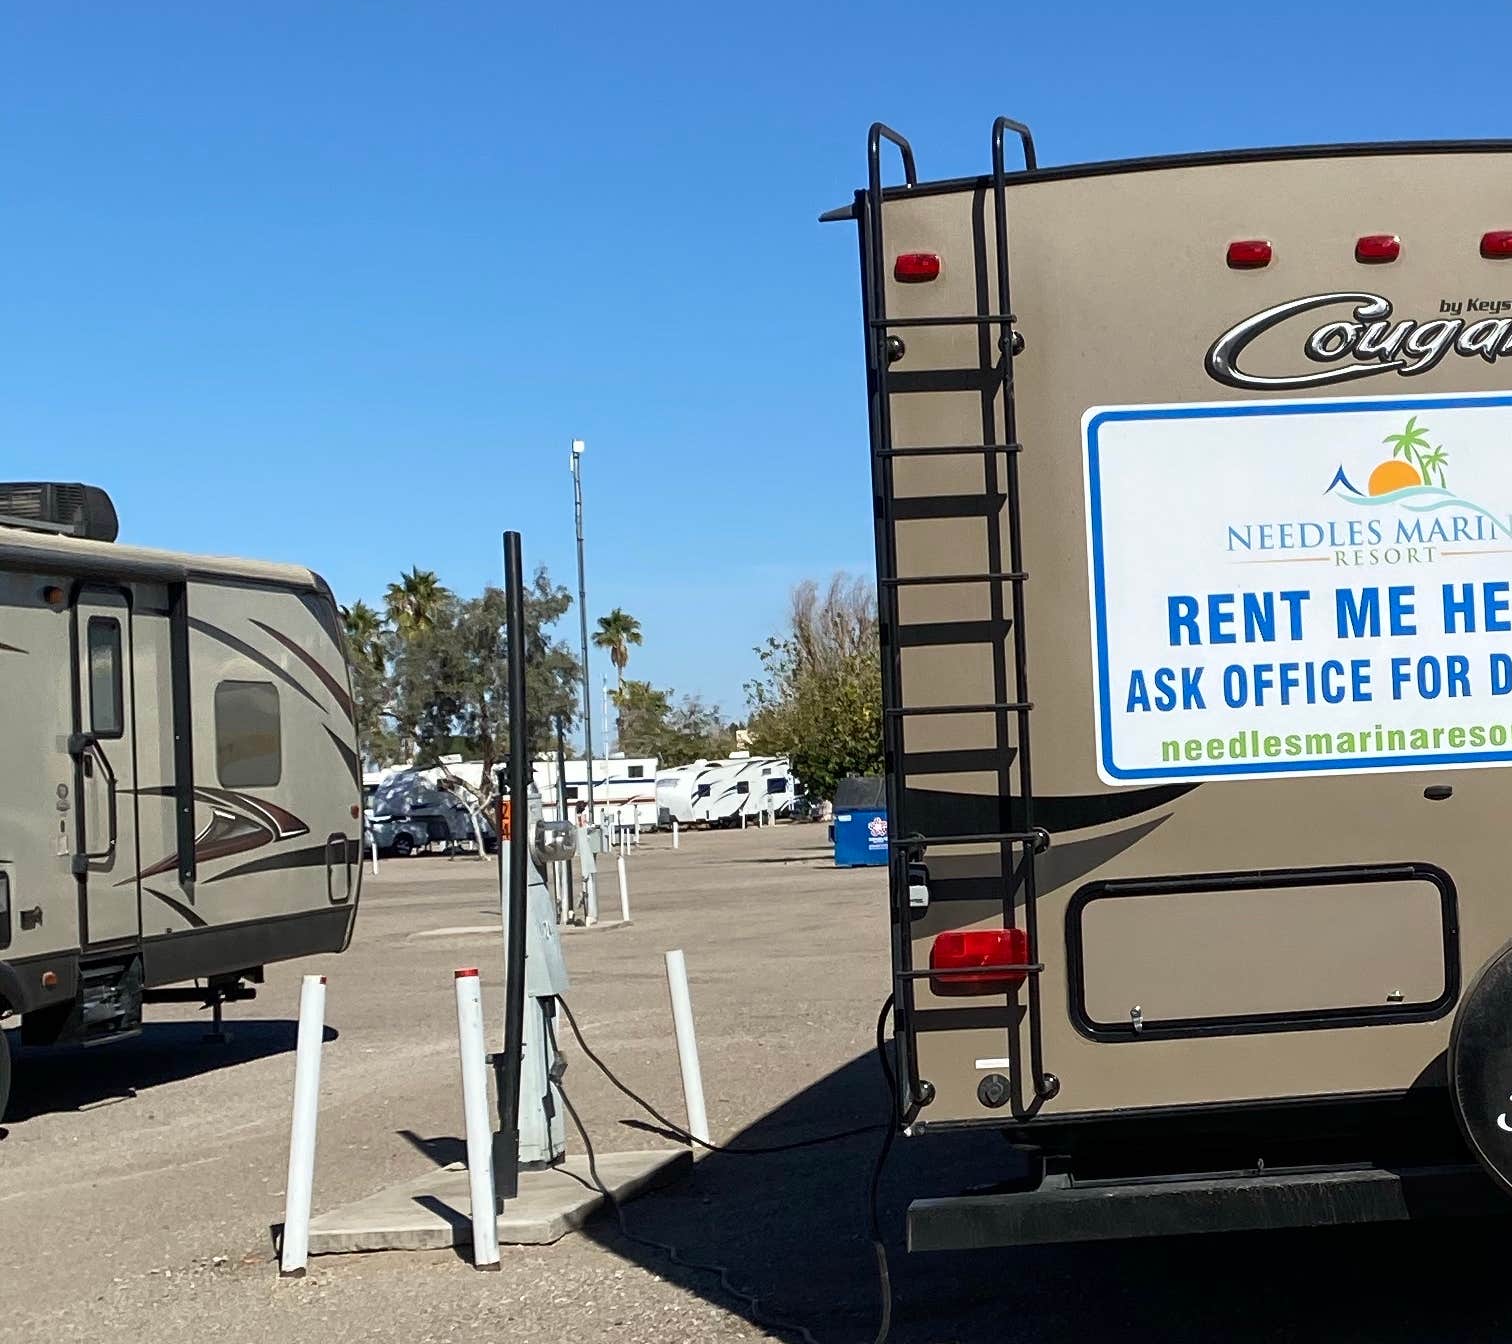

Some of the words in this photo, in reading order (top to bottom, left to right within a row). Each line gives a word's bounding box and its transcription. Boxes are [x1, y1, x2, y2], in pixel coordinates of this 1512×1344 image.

[1440, 299, 1463, 316] by
[1227, 519, 1382, 552] NEEDLES
[1335, 546, 1437, 567] RESORT
[1167, 590, 1310, 646] RENT
[1335, 585, 1417, 638] ME
[1126, 667, 1206, 713] ASK
[1223, 658, 1372, 708] OFFICE
[1392, 655, 1471, 700] FOR
